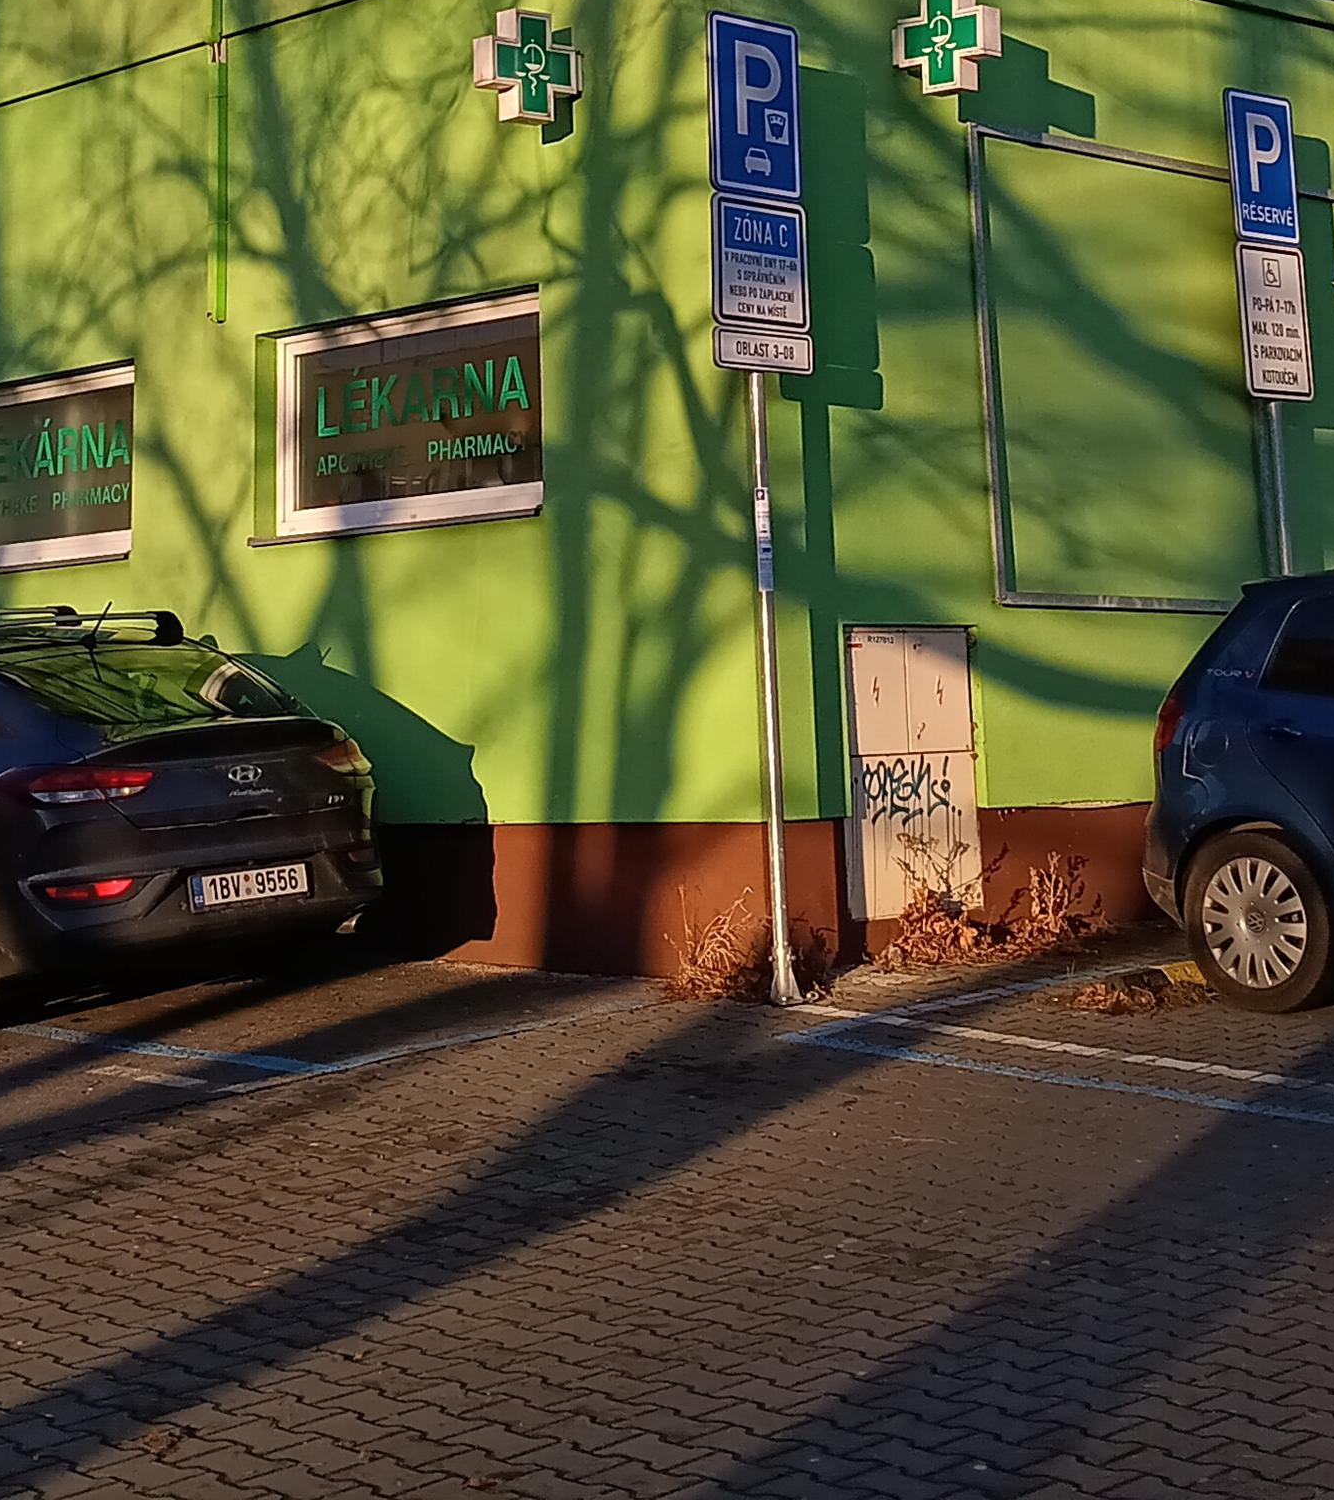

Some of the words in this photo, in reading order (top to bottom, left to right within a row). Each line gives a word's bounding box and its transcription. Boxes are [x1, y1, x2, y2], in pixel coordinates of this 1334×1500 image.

[735, 40, 782, 135] P
[1245, 112, 1282, 193] P
[1242, 200, 1294, 227] RÉSERVÉ
[734, 213, 773, 245] ZÓNA
[779, 224, 788, 248] C
[729, 284, 748, 298] NEBO
[749, 287, 758, 299] PO
[738, 302, 755, 314] CENY
[756, 304, 766, 316] NA
[736, 340, 769, 358] OBLAST
[773, 344, 795, 361] 3-08
[1253, 345, 1259, 359] S
[52, 483, 131, 511] PHARMACY
[209, 874, 241, 900] 1BV
[255, 868, 298, 894] 9556
